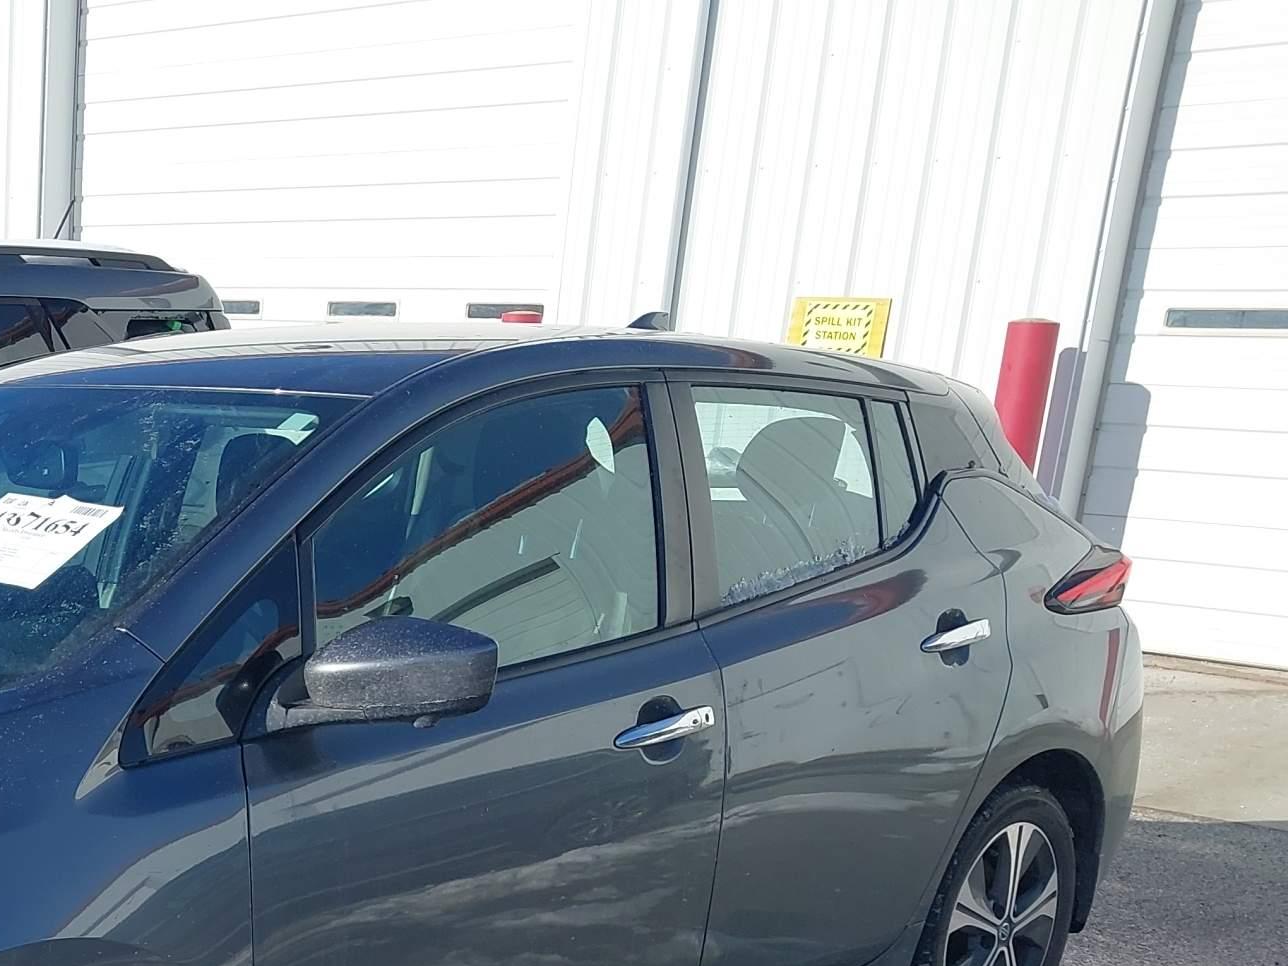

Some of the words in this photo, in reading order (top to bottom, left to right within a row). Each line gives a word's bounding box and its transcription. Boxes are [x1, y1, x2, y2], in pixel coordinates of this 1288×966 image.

[814, 316, 842, 326] SPILL
[846, 317, 863, 327] KIT
[815, 331, 857, 341] STATION
